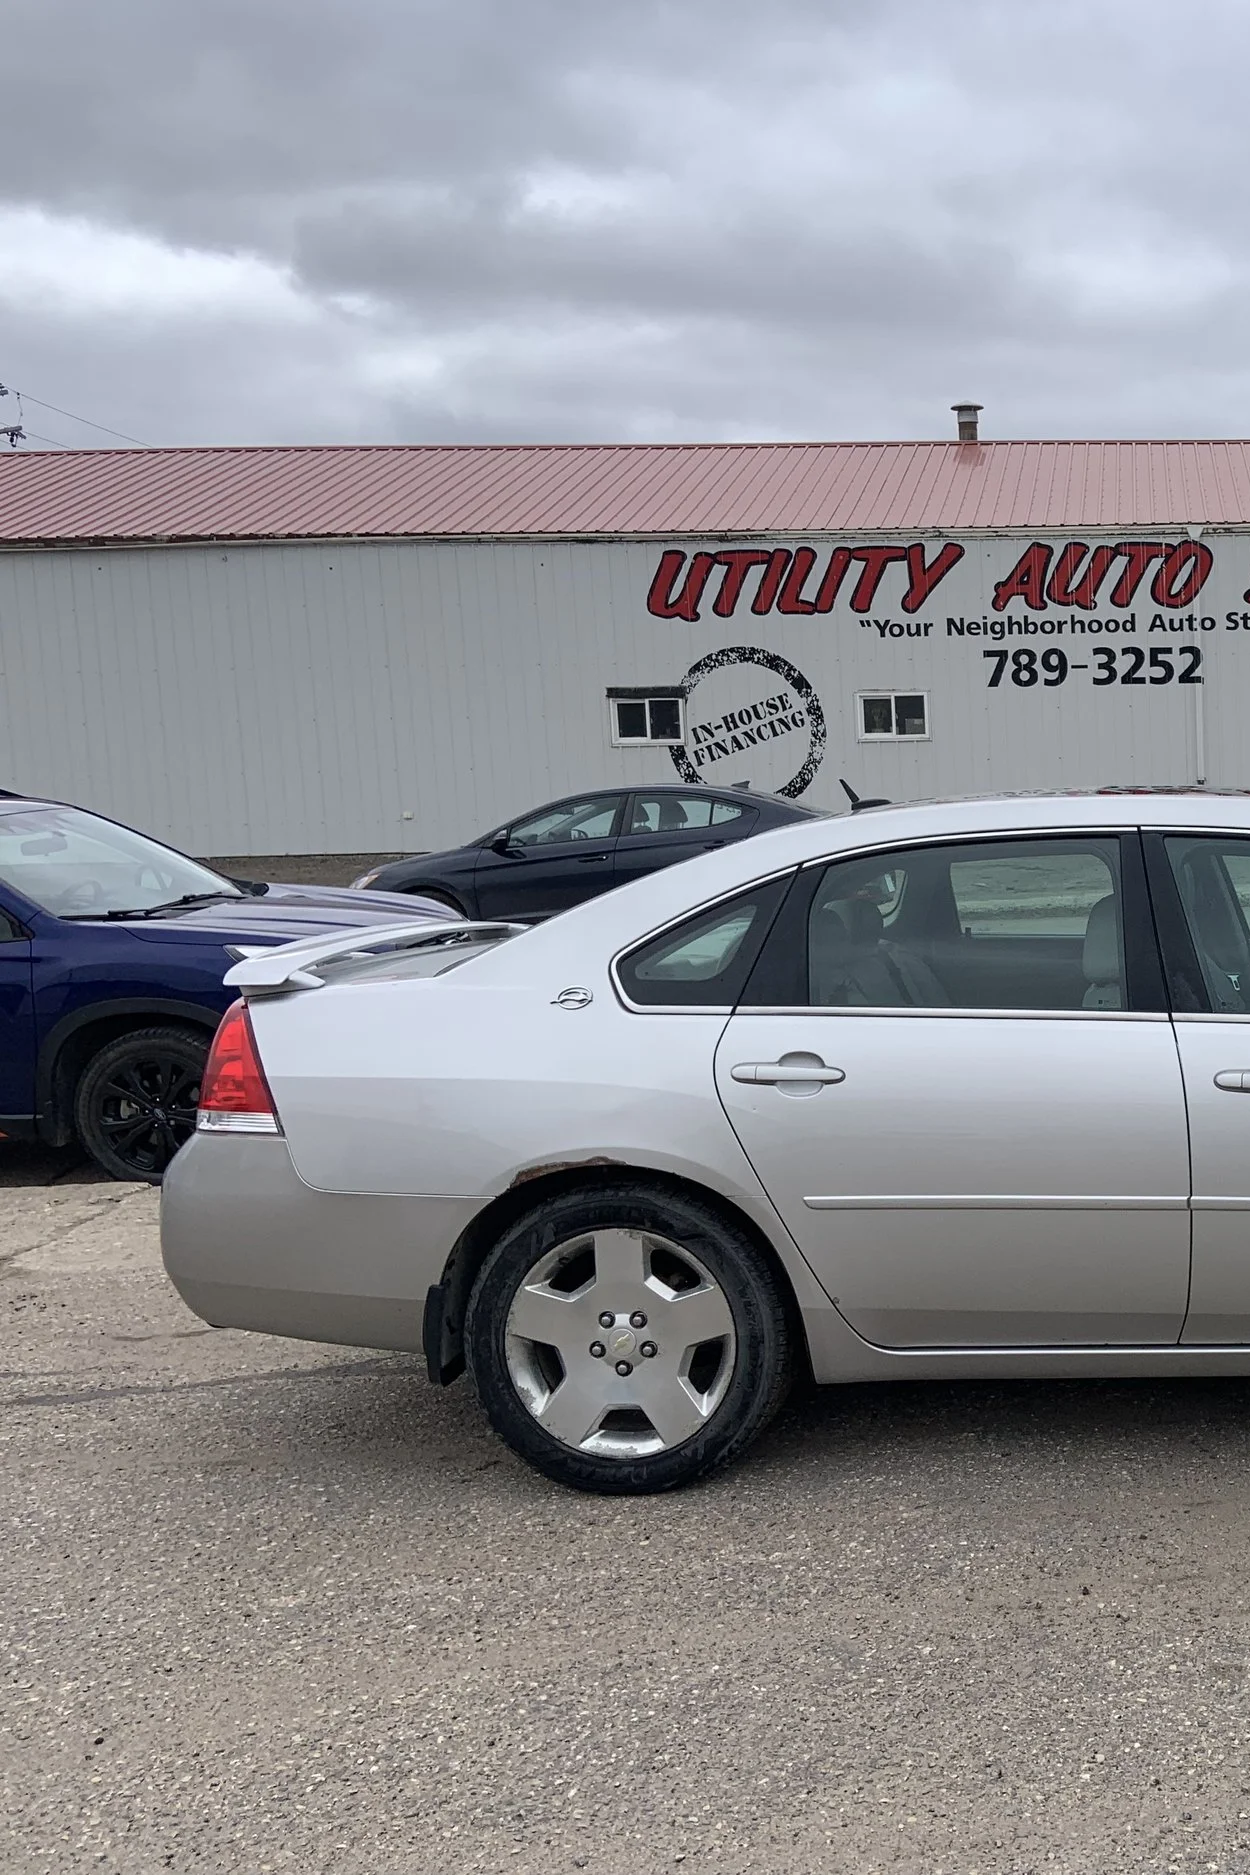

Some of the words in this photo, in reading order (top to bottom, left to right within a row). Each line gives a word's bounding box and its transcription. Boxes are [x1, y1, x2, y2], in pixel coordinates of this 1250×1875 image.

[647, 542, 965, 622] UTILITY
[992, 540, 1213, 612] AUTO
[946, 614, 1136, 641] Neighborhood
[1148, 613, 1216, 632] Auto
[983, 646, 1204, 687] 789-3252
[691, 693, 793, 745] IN-HOUSE
[693, 710, 805, 767] FINANCING
